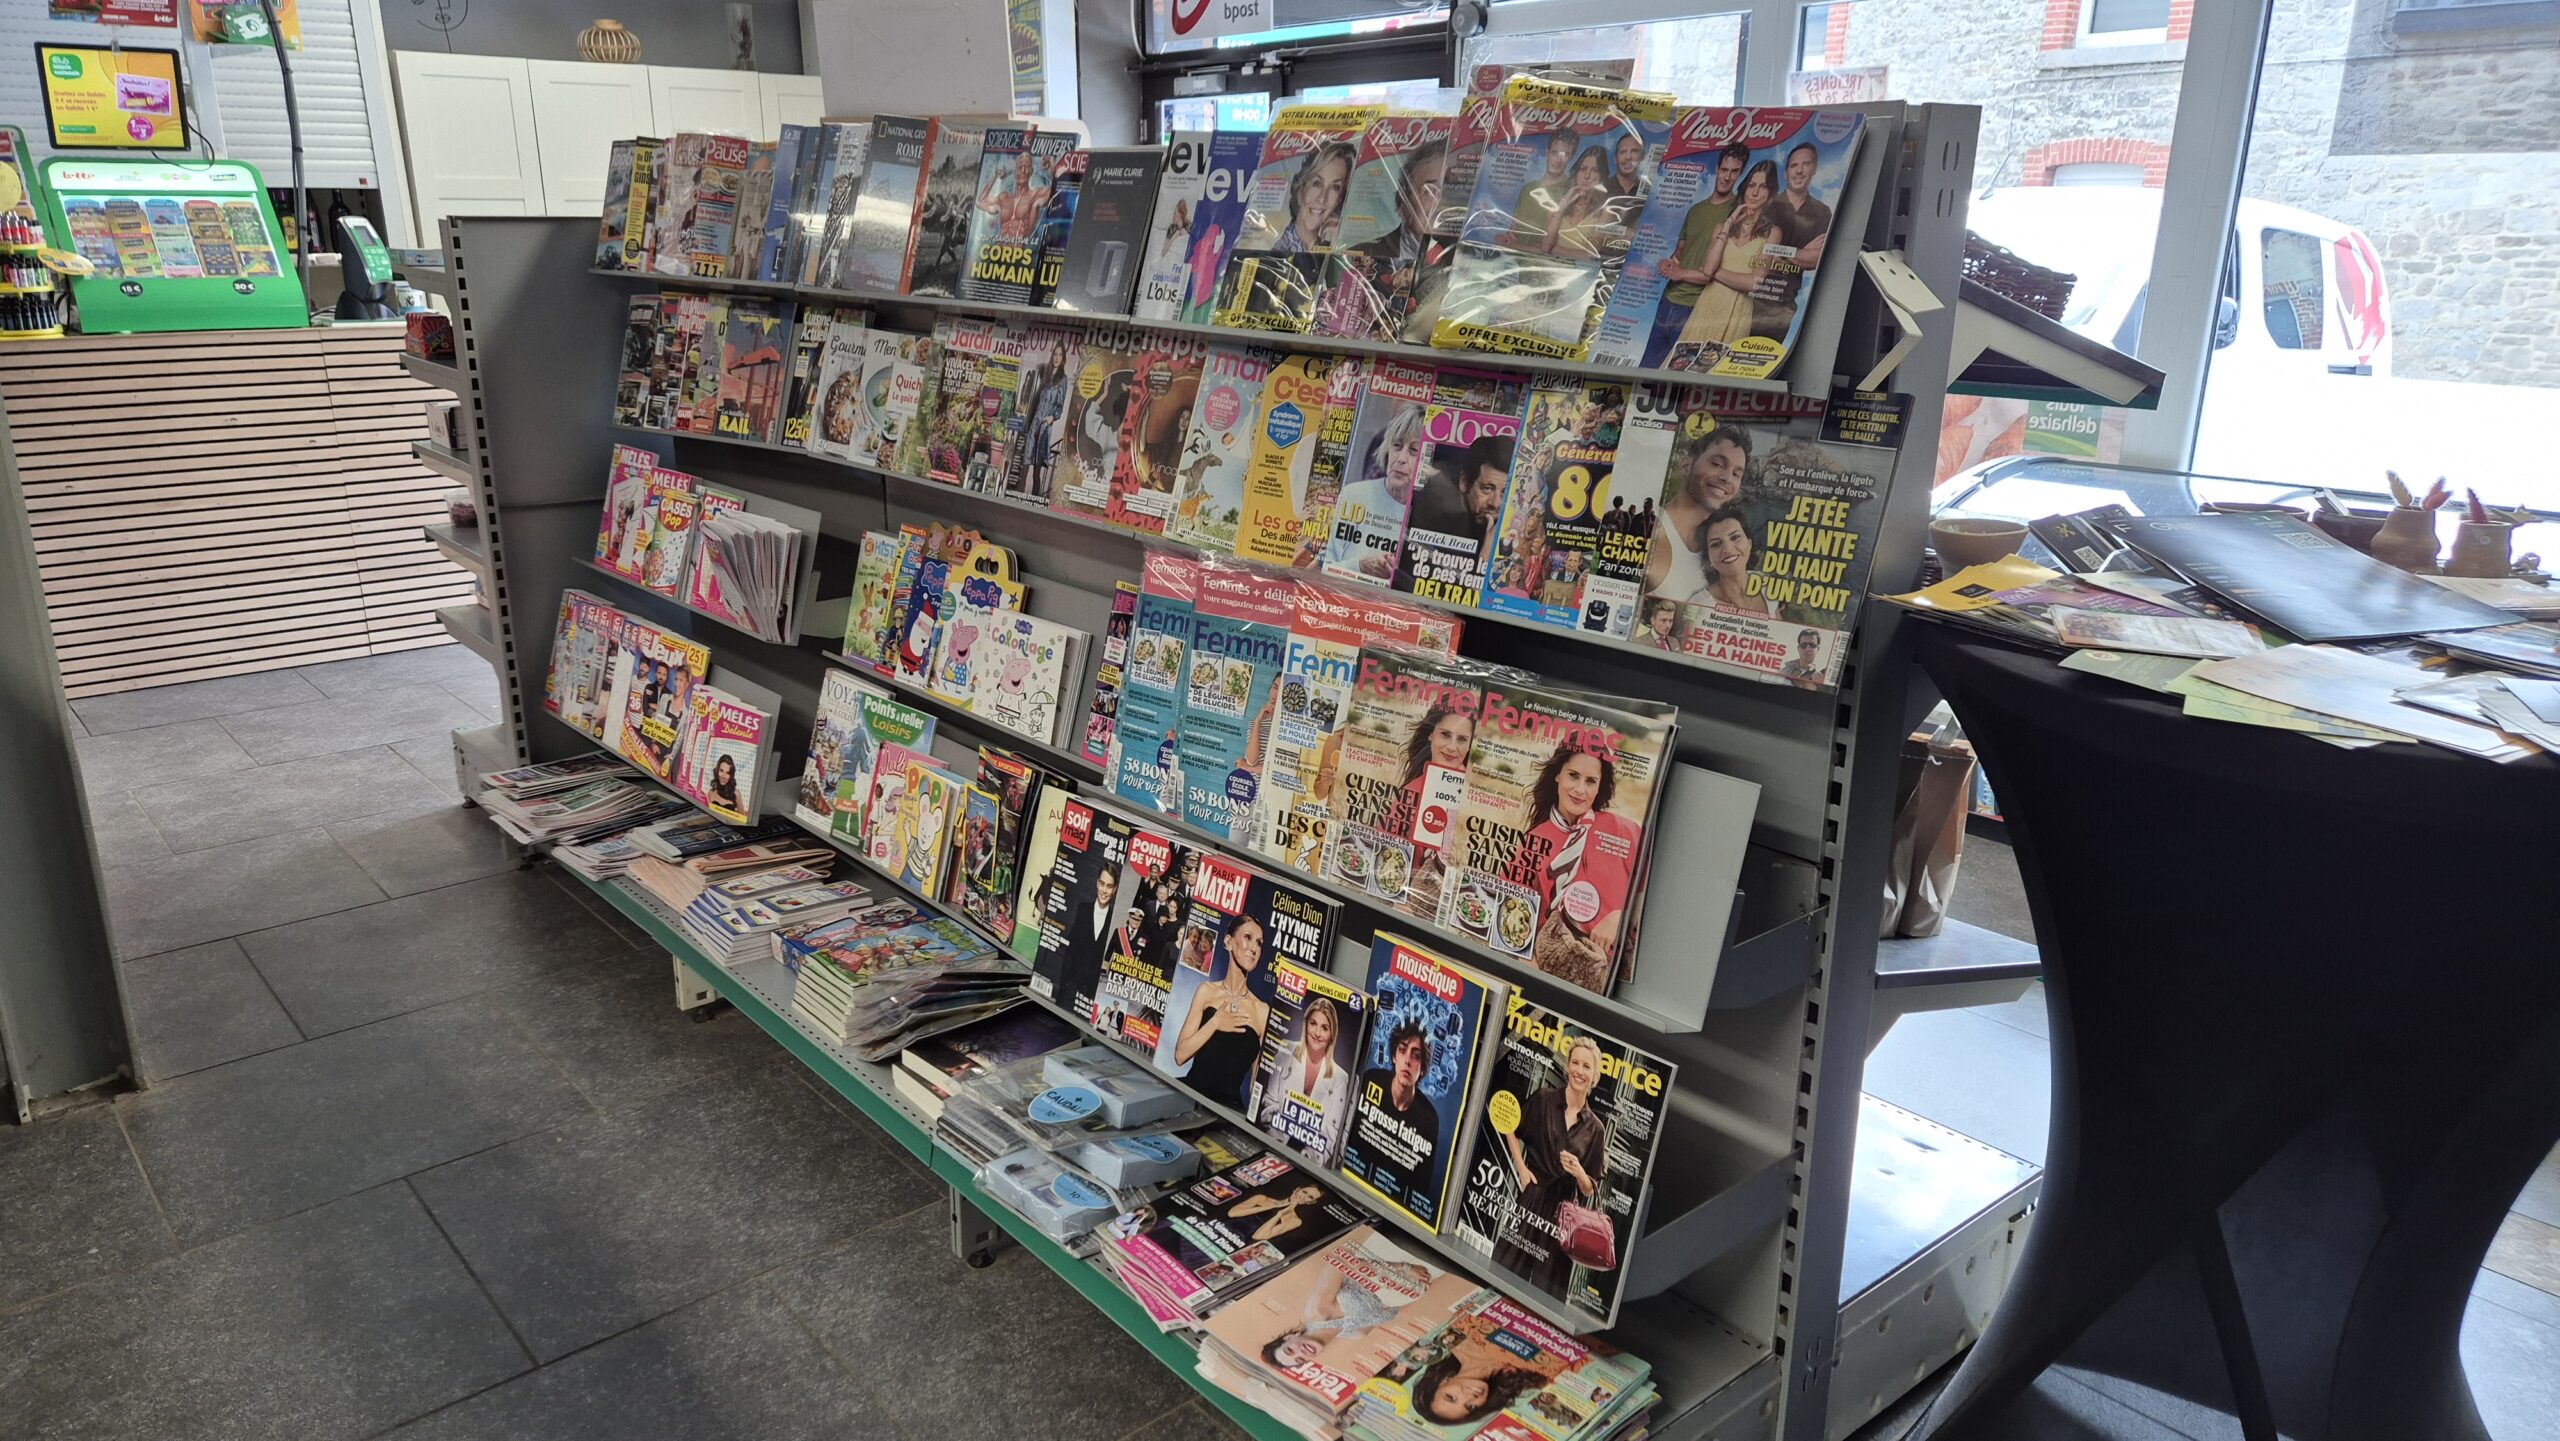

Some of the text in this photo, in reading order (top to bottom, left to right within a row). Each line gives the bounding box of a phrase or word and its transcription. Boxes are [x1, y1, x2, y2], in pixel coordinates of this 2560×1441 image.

[1224, 2, 1259, 23] bpost
[1015, 53, 1039, 66] CASH
[1281, 110, 1304, 119] VOTRE
[1305, 111, 1328, 120] LIVRE
[1338, 112, 1354, 121] PRIX
[1681, 107, 1783, 147] Nous Deux
[887, 127, 914, 139] NATIONAL
[986, 133, 1073, 156] SCIENCE & UNIVERS
[1371, 120, 1404, 147] Nous
[705, 137, 747, 166] Pause
[896, 143, 924, 159] ROME
[1104, 168, 1144, 178] MARIE CURIE
[979, 244, 1033, 265] CORPS
[971, 262, 1035, 285] HUMAIN
[1147, 282, 1178, 304] L'obs
[1459, 327, 1578, 358] OFFRE EXCLUSIVE
[1741, 340, 1775, 353] Cuisine
[896, 374, 923, 391] Quich
[1385, 362, 1433, 382] France
[1371, 375, 1432, 399] Dimanch
[1779, 465, 1874, 487] Son ex l'enlève, la ligote
[1788, 480, 1834, 496] l'embarque
[1835, 486, 1844, 495] de
[1846, 487, 1868, 499] force
[664, 513, 682, 529] Pop
[1340, 501, 1366, 524] LIO
[1785, 495, 1850, 528] JETÉE
[1411, 529, 1476, 552] Patrick Bruel
[1766, 521, 1859, 560] VIVANTE
[1599, 560, 1617, 572] Fan
[1762, 551, 1847, 585] DU HAUT
[964, 578, 986, 603] Peppa
[1746, 574, 1851, 612] D'UN PONT
[1709, 613, 1770, 631] Masculinité toxique,
[992, 626, 1054, 665] Coloriage
[1682, 624, 1787, 657] LES RACINES
[689, 647, 704, 664] 251
[1682, 640, 1783, 670] DE LA HAINE
[1193, 696, 1237, 711] DE GLUCIDES
[1194, 689, 1237, 705] DE LÉGUMES
[864, 696, 895, 720] Points
[900, 712, 925, 729] relier
[1524, 700, 1534, 710] Le
[1534, 702, 1559, 716] féminin
[1559, 708, 1578, 723] belge
[1584, 716, 1600, 728] plus
[1600, 719, 1608, 728] lu
[872, 719, 912, 740] Loisirs
[1279, 727, 1315, 742] DE MOULES
[1481, 692, 1625, 763] Femmes
[1189, 786, 1250, 817] 58 BONS
[1066, 809, 1091, 831] soir
[1064, 824, 1086, 845] mag
[1094, 828, 1118, 848] George
[1466, 815, 1553, 856] CUISINER
[1132, 838, 1169, 861] POINT
[1467, 834, 1545, 872] SANS SE
[1130, 851, 1167, 873] DE VUE
[1212, 866, 1236, 882] PARIS
[1468, 850, 1536, 887] RUINER
[1469, 869, 1503, 886] RECETTES
[1504, 880, 1523, 893] AVEC
[1523, 887, 1537, 897] LES
[1471, 876, 1525, 900] SUPER PROMOS
[1273, 890, 1323, 926] Céline Dion
[1269, 911, 1321, 947] L'HYMNE
[1272, 929, 1318, 963] À LA VIE
[1113, 952, 1163, 978] FUNÉRAILLES DE
[1396, 952, 1457, 997] moustique
[1107, 970, 1157, 998] LES ROYAUX
[1279, 967, 1308, 991] TÉLÉ
[1311, 980, 1347, 1001] LE MOINS CHER
[1276, 986, 1303, 1005] POCKET
[1046, 1090, 1090, 1117] CAUDALIE
[1367, 1086, 1381, 1104] IA
[1498, 1093, 1517, 1106] MODE
[1284, 1099, 1322, 1131] Le prix
[1358, 1093, 1368, 1115] La
[1368, 1105, 1398, 1135] grosse
[1398, 1120, 1433, 1157] fatigue
[1272, 1113, 1326, 1153] du succès
[1472, 1158, 1504, 1188] 50
[1468, 1191, 1522, 1232] BEAUTÉ
[1483, 1184, 1568, 1243] DÉCOUVERTES
[1185, 1215, 1236, 1254] de Céline Dion
[1322, 1254, 1380, 1293] Mamans
[1334, 1246, 1421, 1300] après 40 ans
